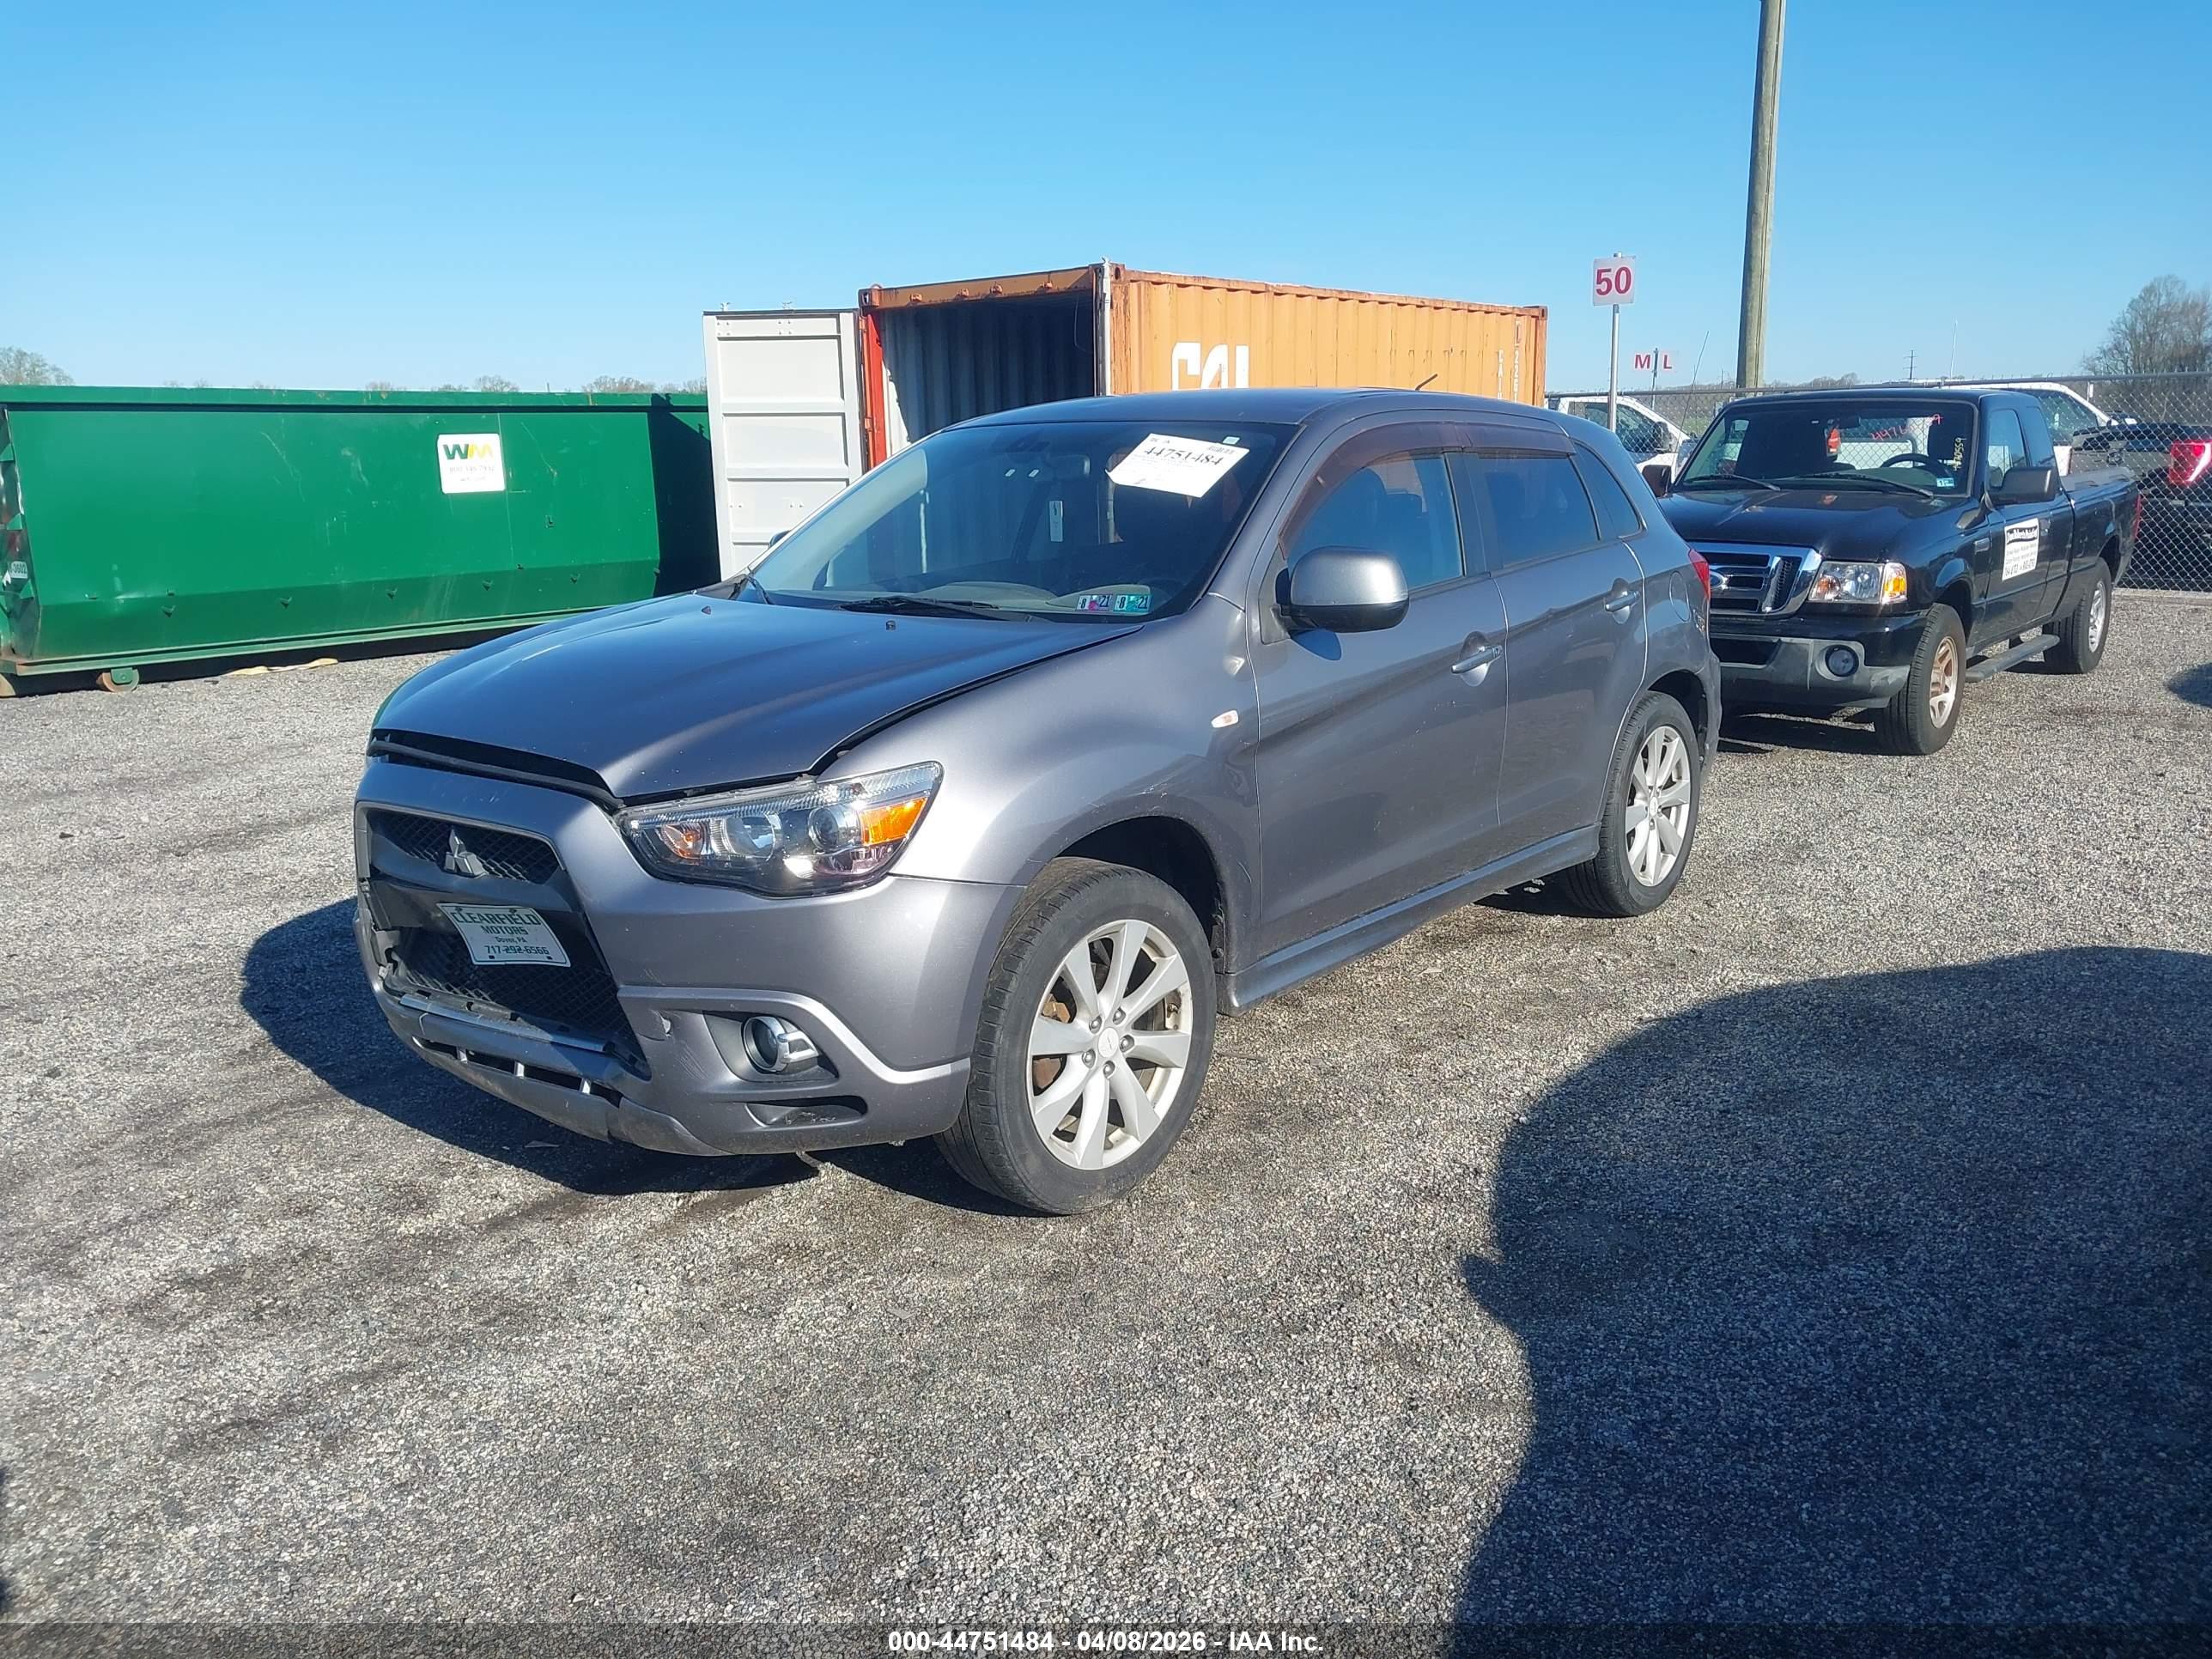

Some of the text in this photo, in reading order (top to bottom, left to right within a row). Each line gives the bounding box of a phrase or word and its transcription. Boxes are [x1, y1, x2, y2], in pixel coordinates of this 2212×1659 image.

[1595, 266, 1632, 296] 50
[1634, 354, 1673, 369] M L
[442, 443, 494, 459] WM
[1144, 447, 1224, 465] 44751484
[1099, 595, 1110, 607] 21
[1137, 596, 1148, 609] 21
[452, 912, 541, 925] CLEARFIELD
[481, 925, 529, 935] MOTORS
[484, 945, 550, 955] 717-292-6566
